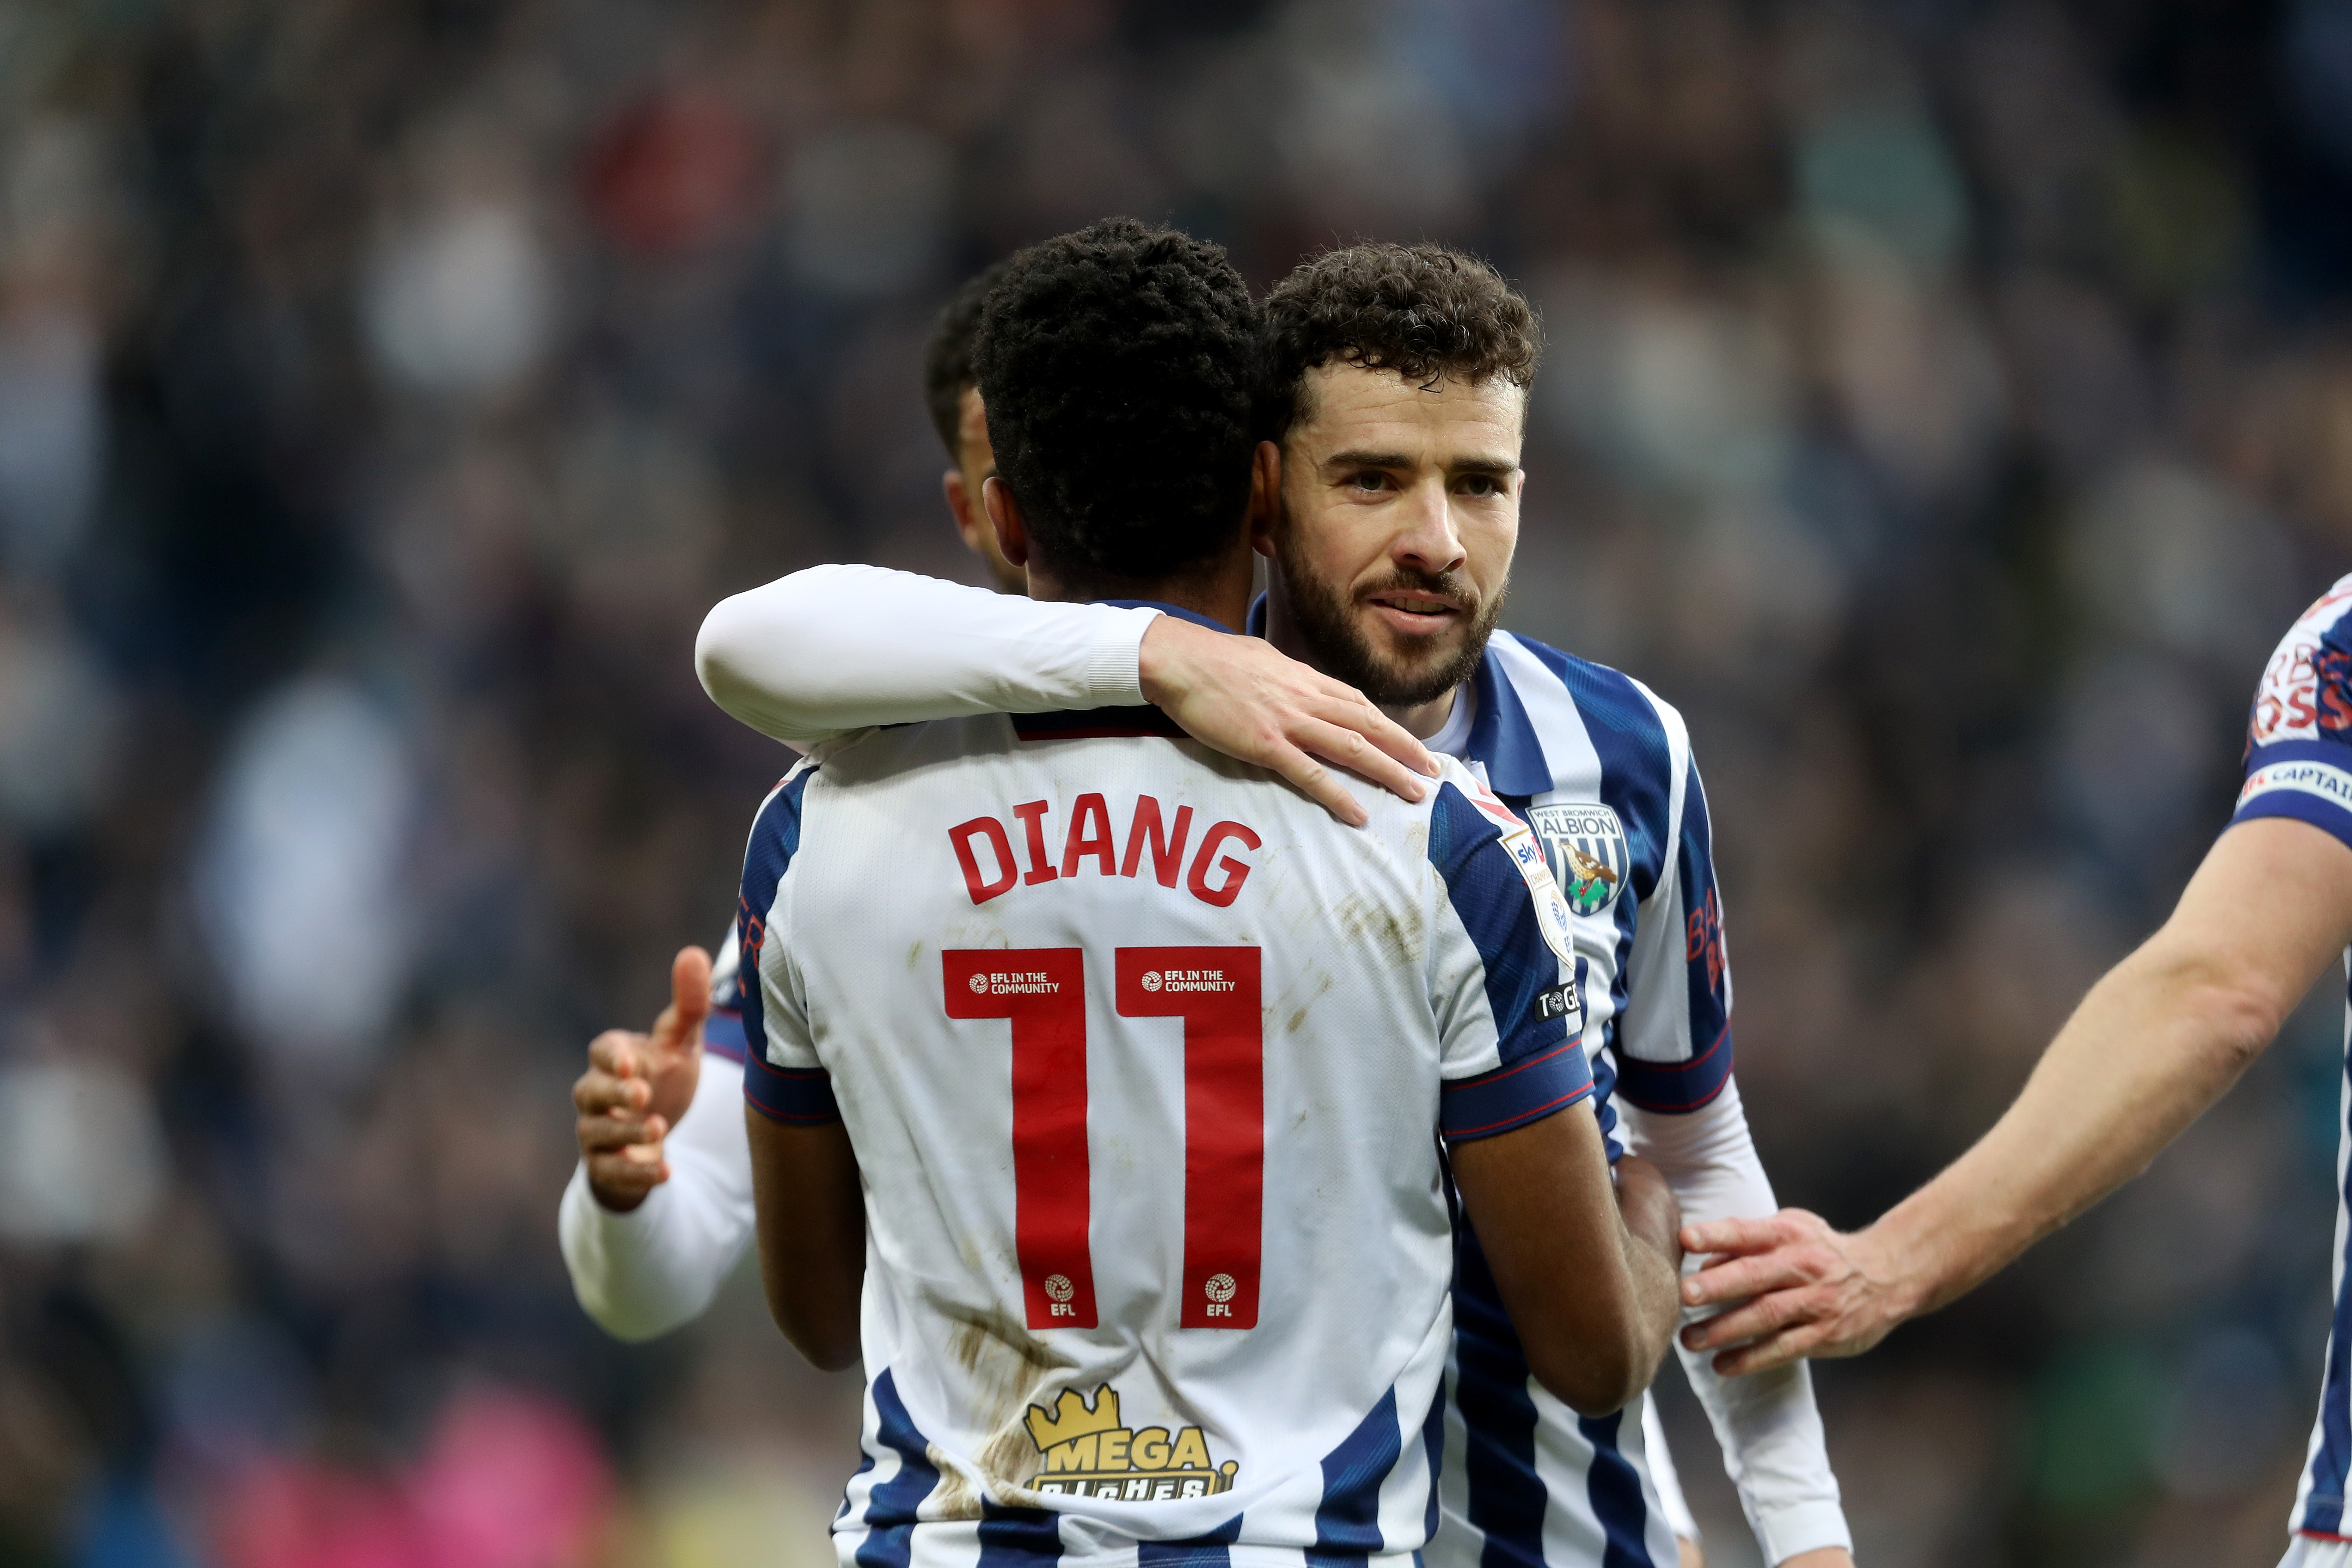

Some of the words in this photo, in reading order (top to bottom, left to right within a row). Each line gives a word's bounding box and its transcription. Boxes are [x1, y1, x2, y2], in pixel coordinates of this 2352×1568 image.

[2272, 768, 2352, 800] CAPTAI
[1543, 818, 1616, 835] ALBION
[948, 793, 1262, 908] DIANG
[990, 973, 1010, 983] EFL
[1011, 973, 1024, 983] IN
[1026, 972, 1047, 982] THE
[1164, 970, 1185, 980] EFL
[1186, 970, 1200, 980] IN
[1201, 970, 1223, 980] THE
[991, 983, 1059, 994] COMMUNITY
[1165, 981, 1235, 992] COMMUNITY
[941, 946, 1263, 1329] 11
[1050, 1304, 1075, 1316] EFL
[1207, 1304, 1232, 1317] EFL
[1046, 1427, 1212, 1471] MEGA
